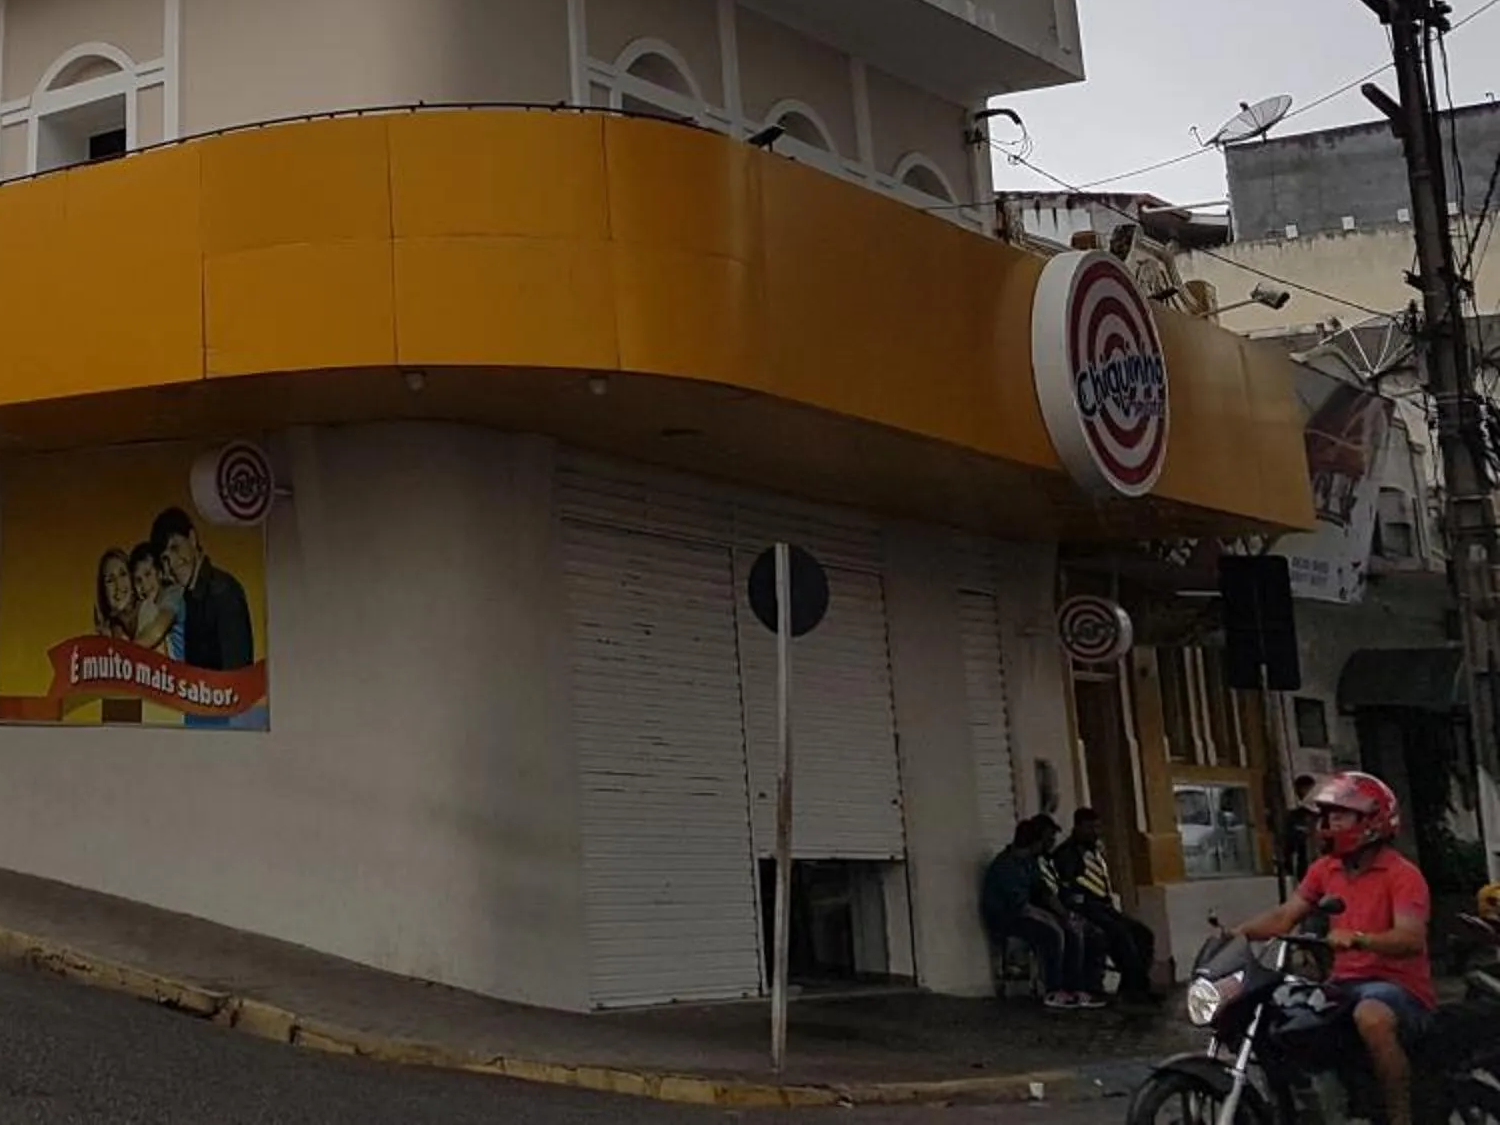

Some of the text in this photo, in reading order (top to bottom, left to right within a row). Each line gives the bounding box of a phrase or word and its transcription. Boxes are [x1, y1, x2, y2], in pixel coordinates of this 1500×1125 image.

[1077, 341, 1164, 417] Chiquinho
[70, 645, 80, 683] É
[83, 648, 133, 681] muito
[136, 663, 176, 694] mais
